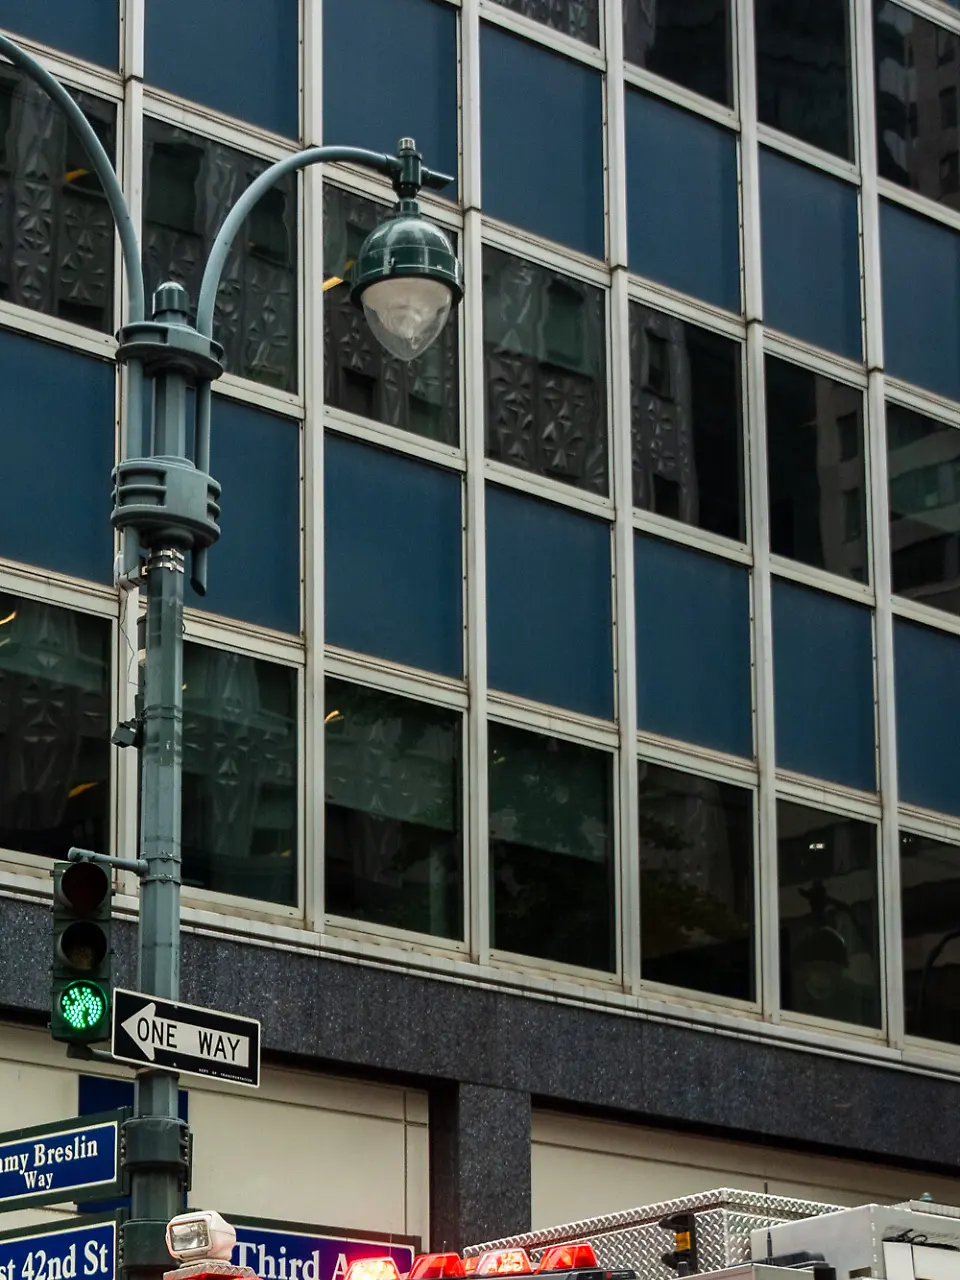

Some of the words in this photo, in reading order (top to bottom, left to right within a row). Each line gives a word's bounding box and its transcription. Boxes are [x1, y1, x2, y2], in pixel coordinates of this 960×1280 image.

[137, 1016, 178, 1049] ONE
[198, 1029, 241, 1062] WAY
[33, 1135, 99, 1167] Breslin
[24, 1170, 54, 1190] Way
[83, 1240, 109, 1276] St
